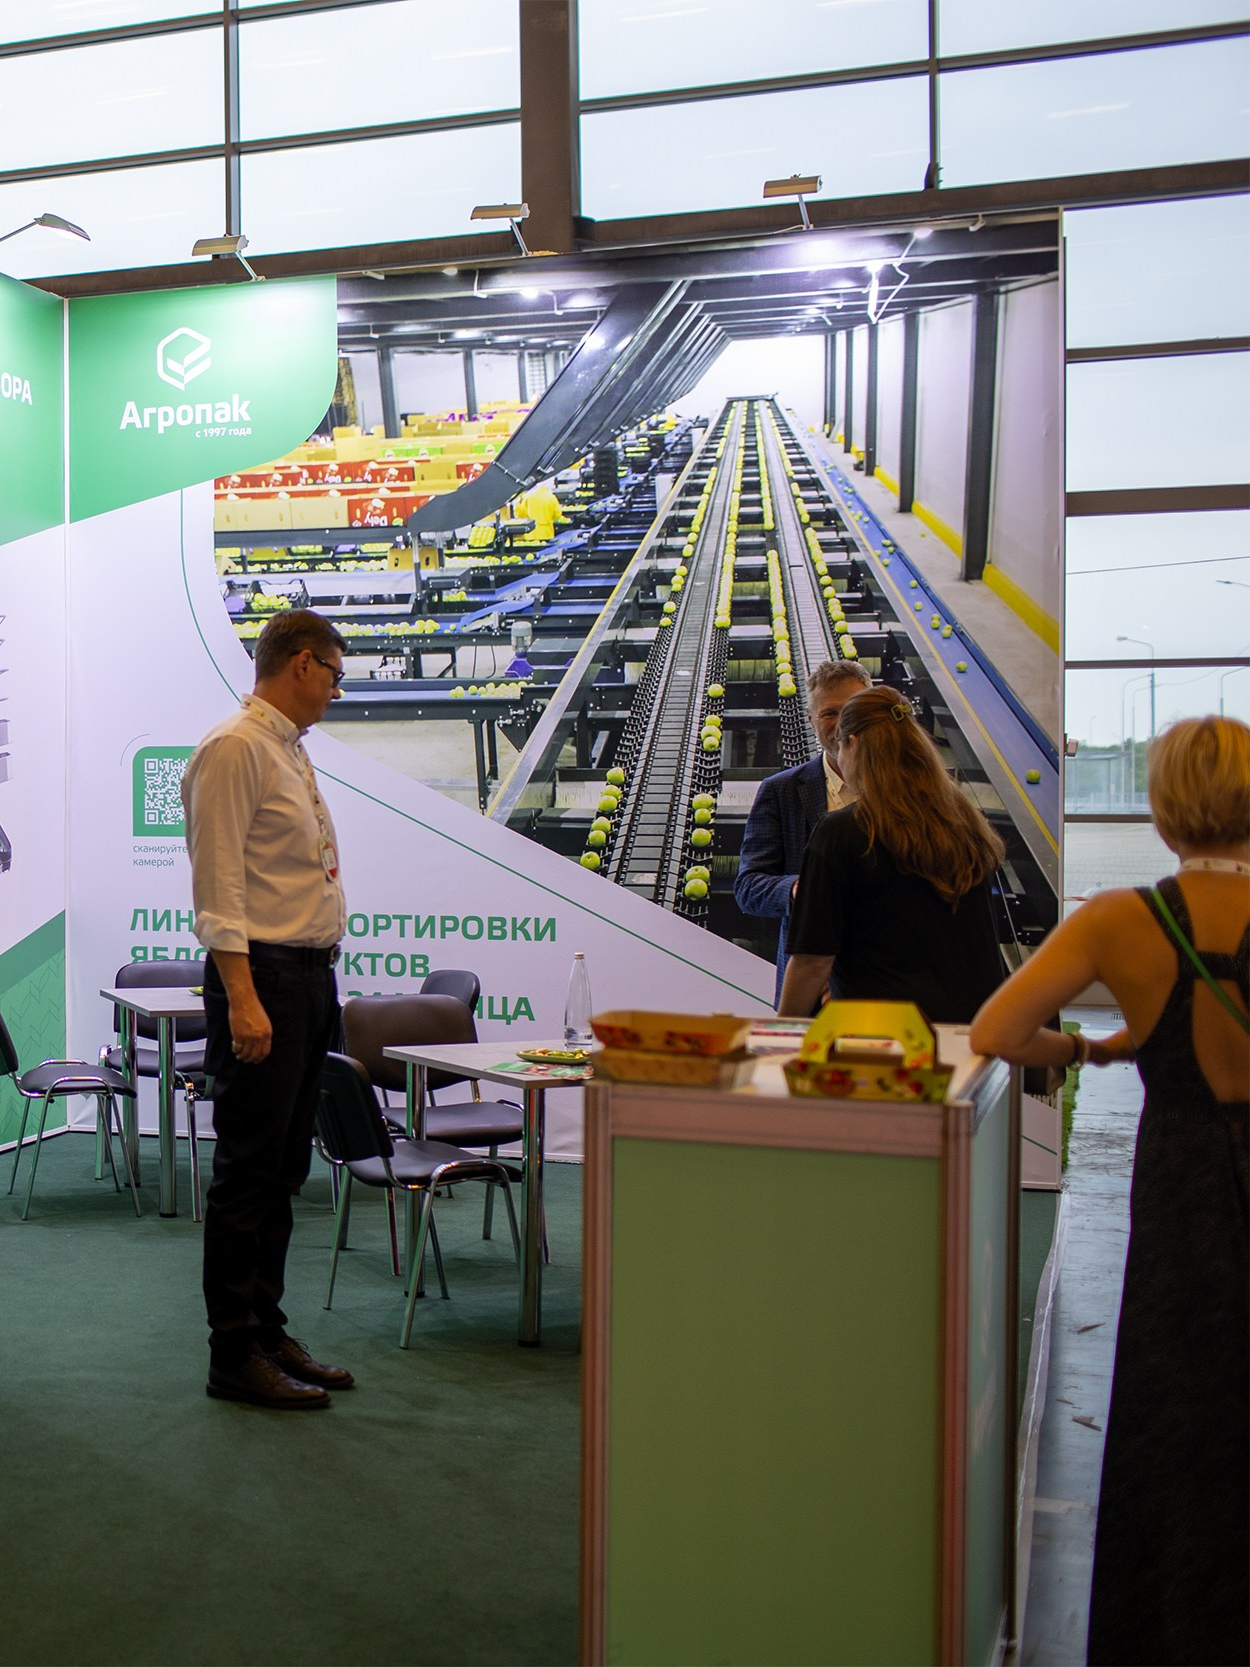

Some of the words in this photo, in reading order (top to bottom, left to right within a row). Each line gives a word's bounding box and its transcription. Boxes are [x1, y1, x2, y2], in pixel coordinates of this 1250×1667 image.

[119, 393, 251, 434] Агропак
[203, 427, 227, 438] 1997
[228, 426, 252, 437] года
[133, 844, 188, 854] сканируйте
[133, 858, 174, 868] камерой
[130, 908, 193, 932] ЛИН
[343, 913, 556, 942] ОРТИРОВКИ
[340, 952, 430, 977] КТОВ
